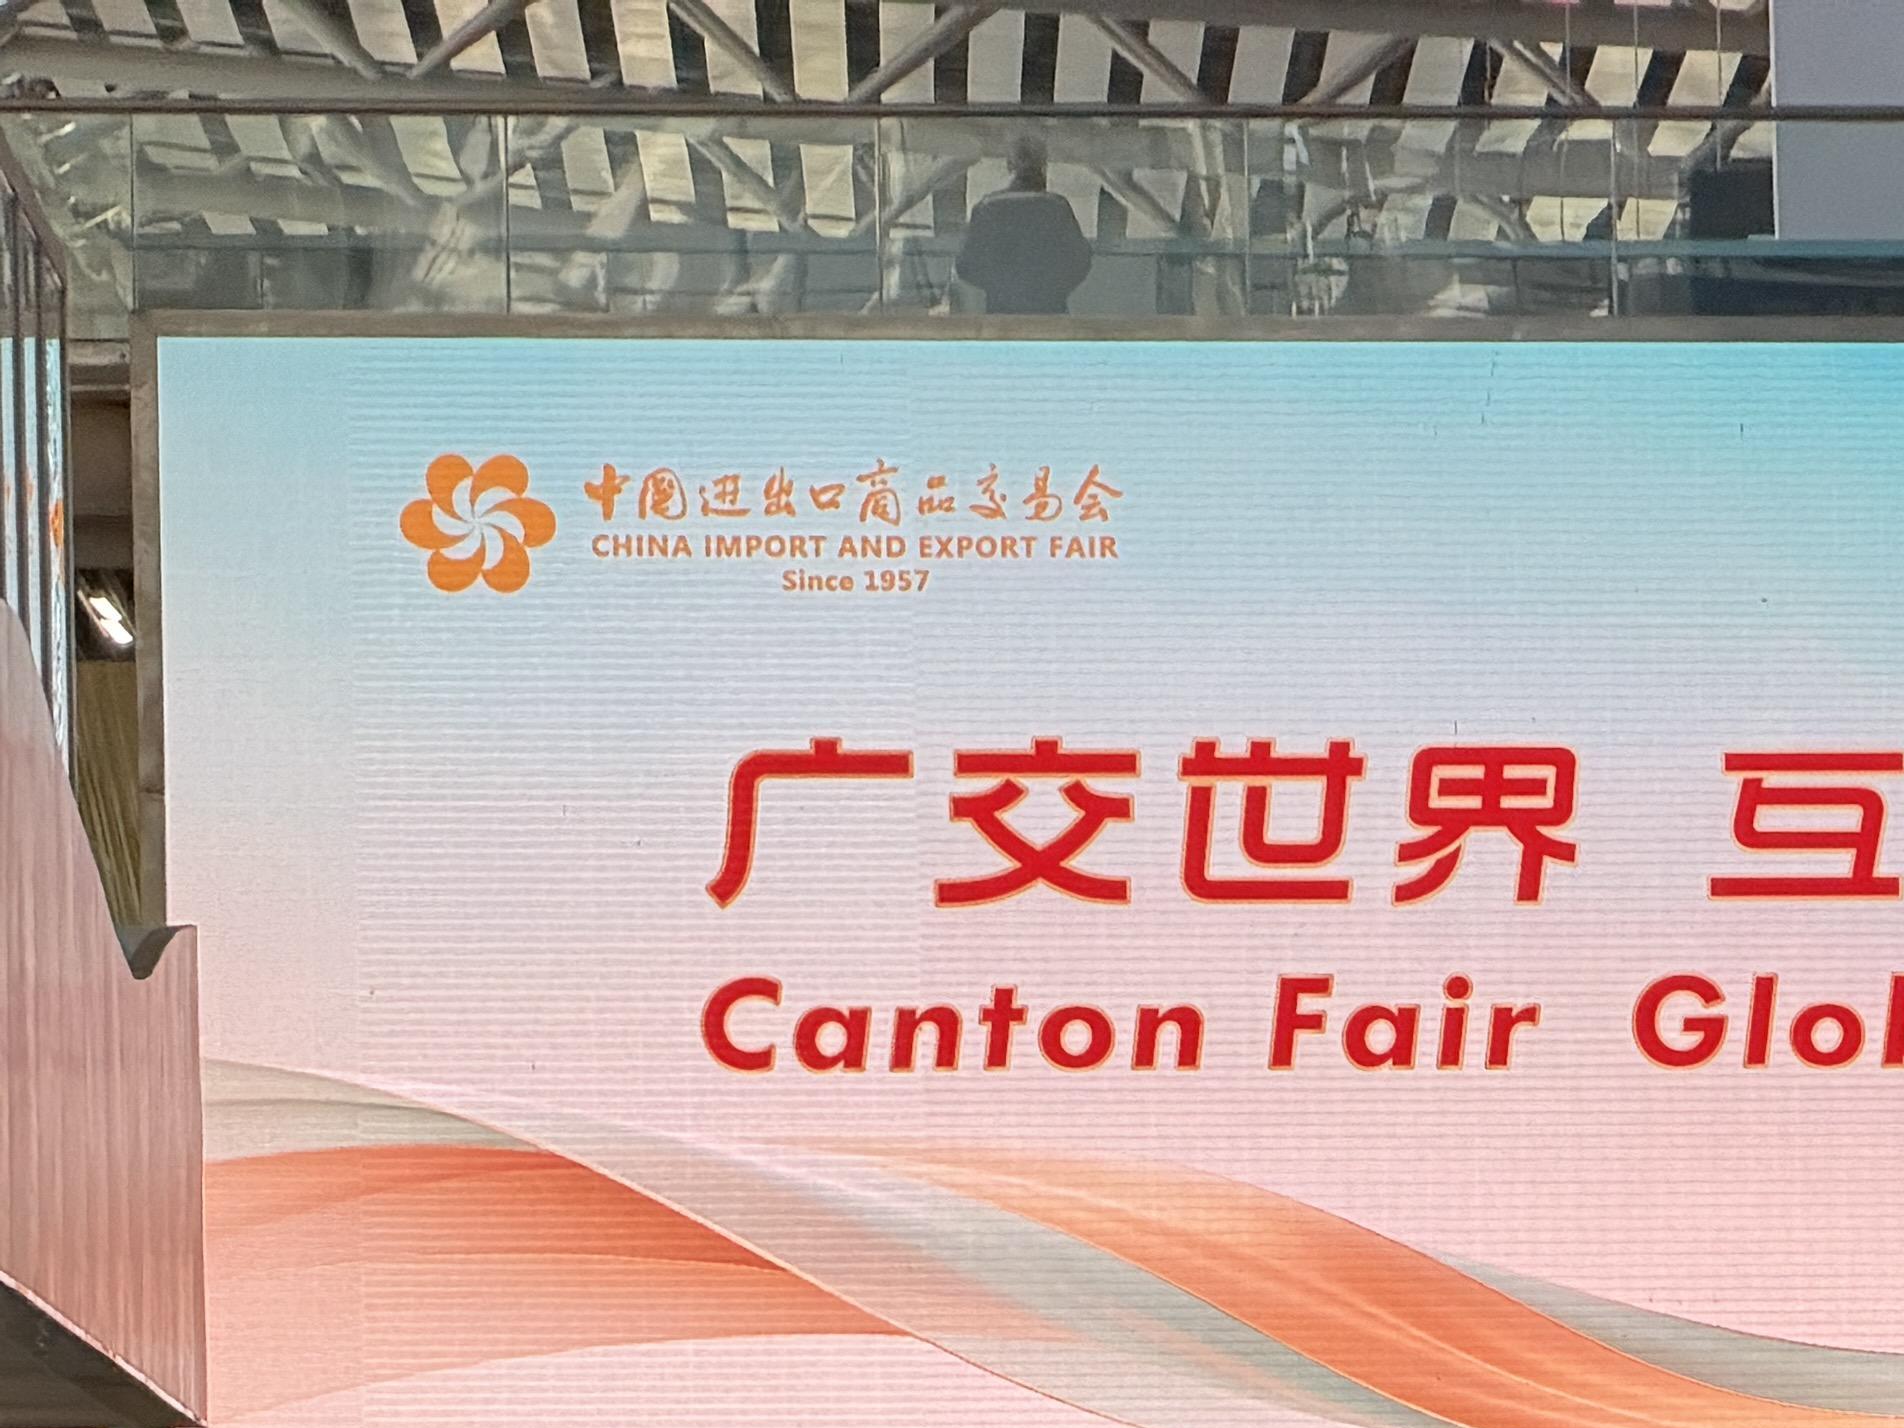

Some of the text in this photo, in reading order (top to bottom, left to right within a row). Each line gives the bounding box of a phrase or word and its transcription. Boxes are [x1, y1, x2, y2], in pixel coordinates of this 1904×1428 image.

[592, 534, 1118, 558] CHINA IMPORT AND EXPORT FAIR
[782, 569, 930, 592] Since 1957
[705, 734, 1582, 908] 广交世界
[702, 977, 1205, 1075] Canton
[1268, 973, 1541, 1072] Fair
